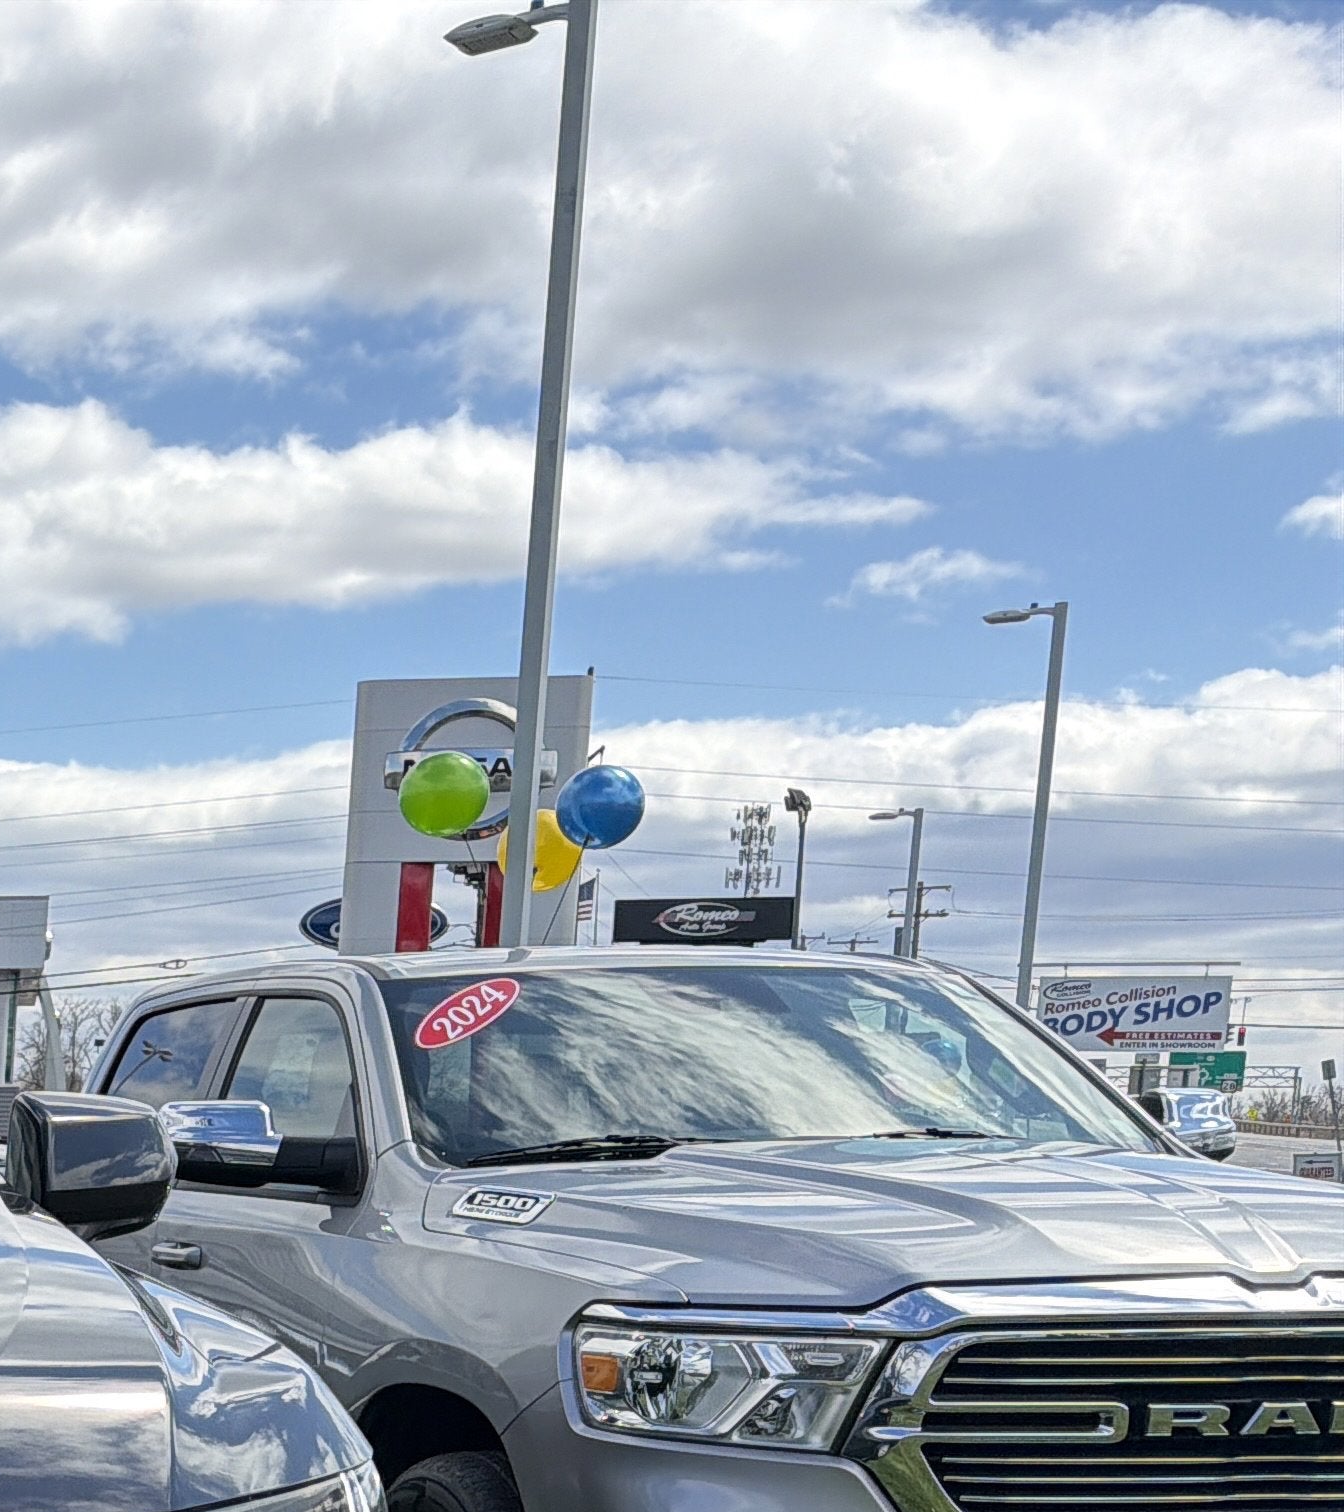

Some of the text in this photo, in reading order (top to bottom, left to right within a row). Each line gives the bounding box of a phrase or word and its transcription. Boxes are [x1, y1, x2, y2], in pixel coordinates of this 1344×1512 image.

[674, 904, 740, 922] Romeo
[432, 984, 508, 1040] 2024
[1044, 985, 1177, 1016] Romeo Collision
[1132, 991, 1223, 1025] SHOP
[1125, 1032, 1212, 1040] FREE ESTIMATES
[1160, 1041, 1216, 1049] SHOWROOM
[472, 1193, 536, 1210] 1500
[1145, 1402, 1344, 1436] RA
